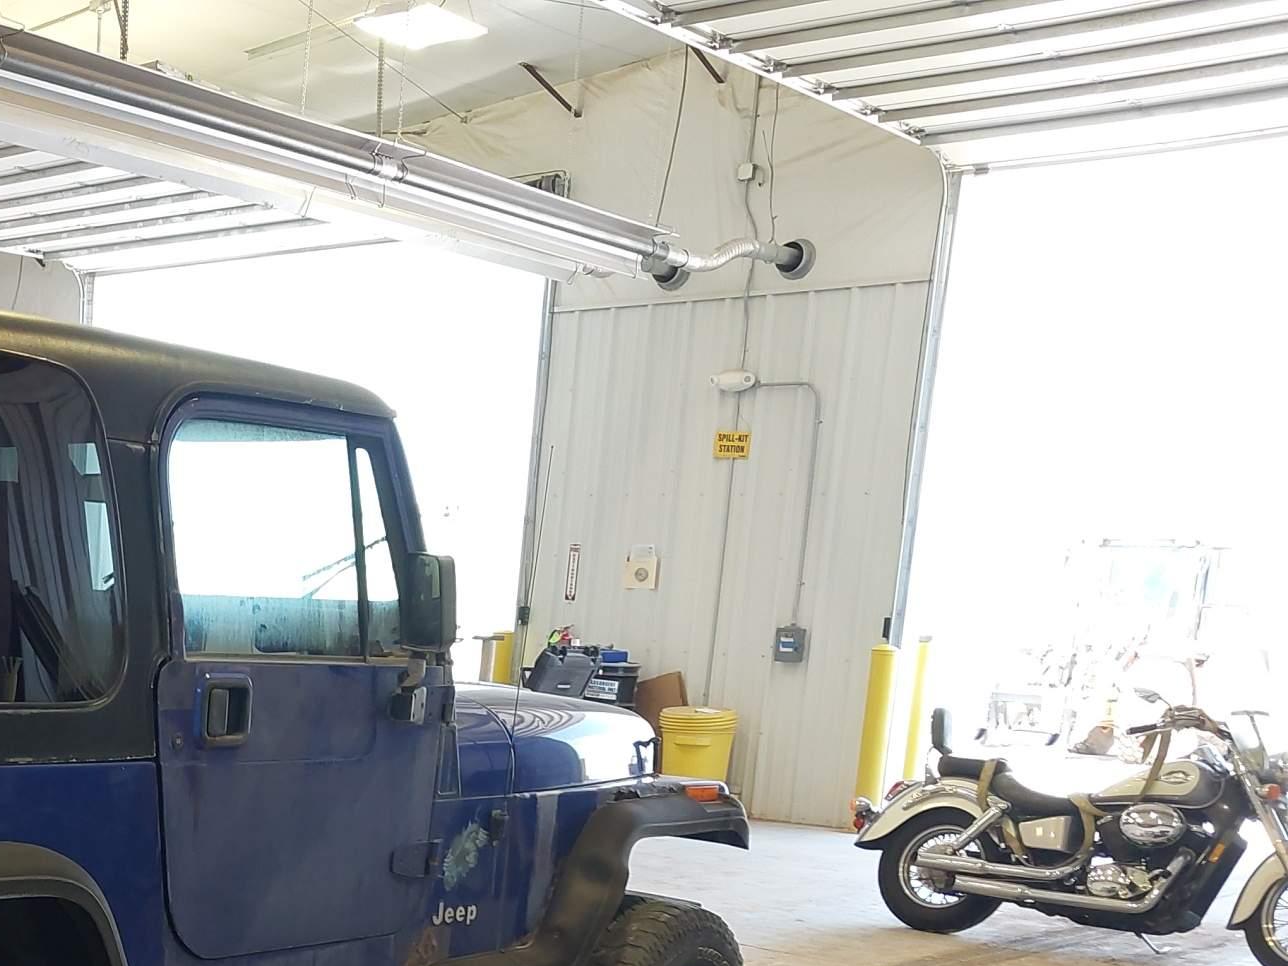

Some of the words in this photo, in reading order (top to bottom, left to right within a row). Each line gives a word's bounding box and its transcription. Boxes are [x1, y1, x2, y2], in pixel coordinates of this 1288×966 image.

[717, 433, 748, 442] SPILL-KIT
[718, 444, 745, 453] STATION
[432, 901, 478, 926] Jeep
